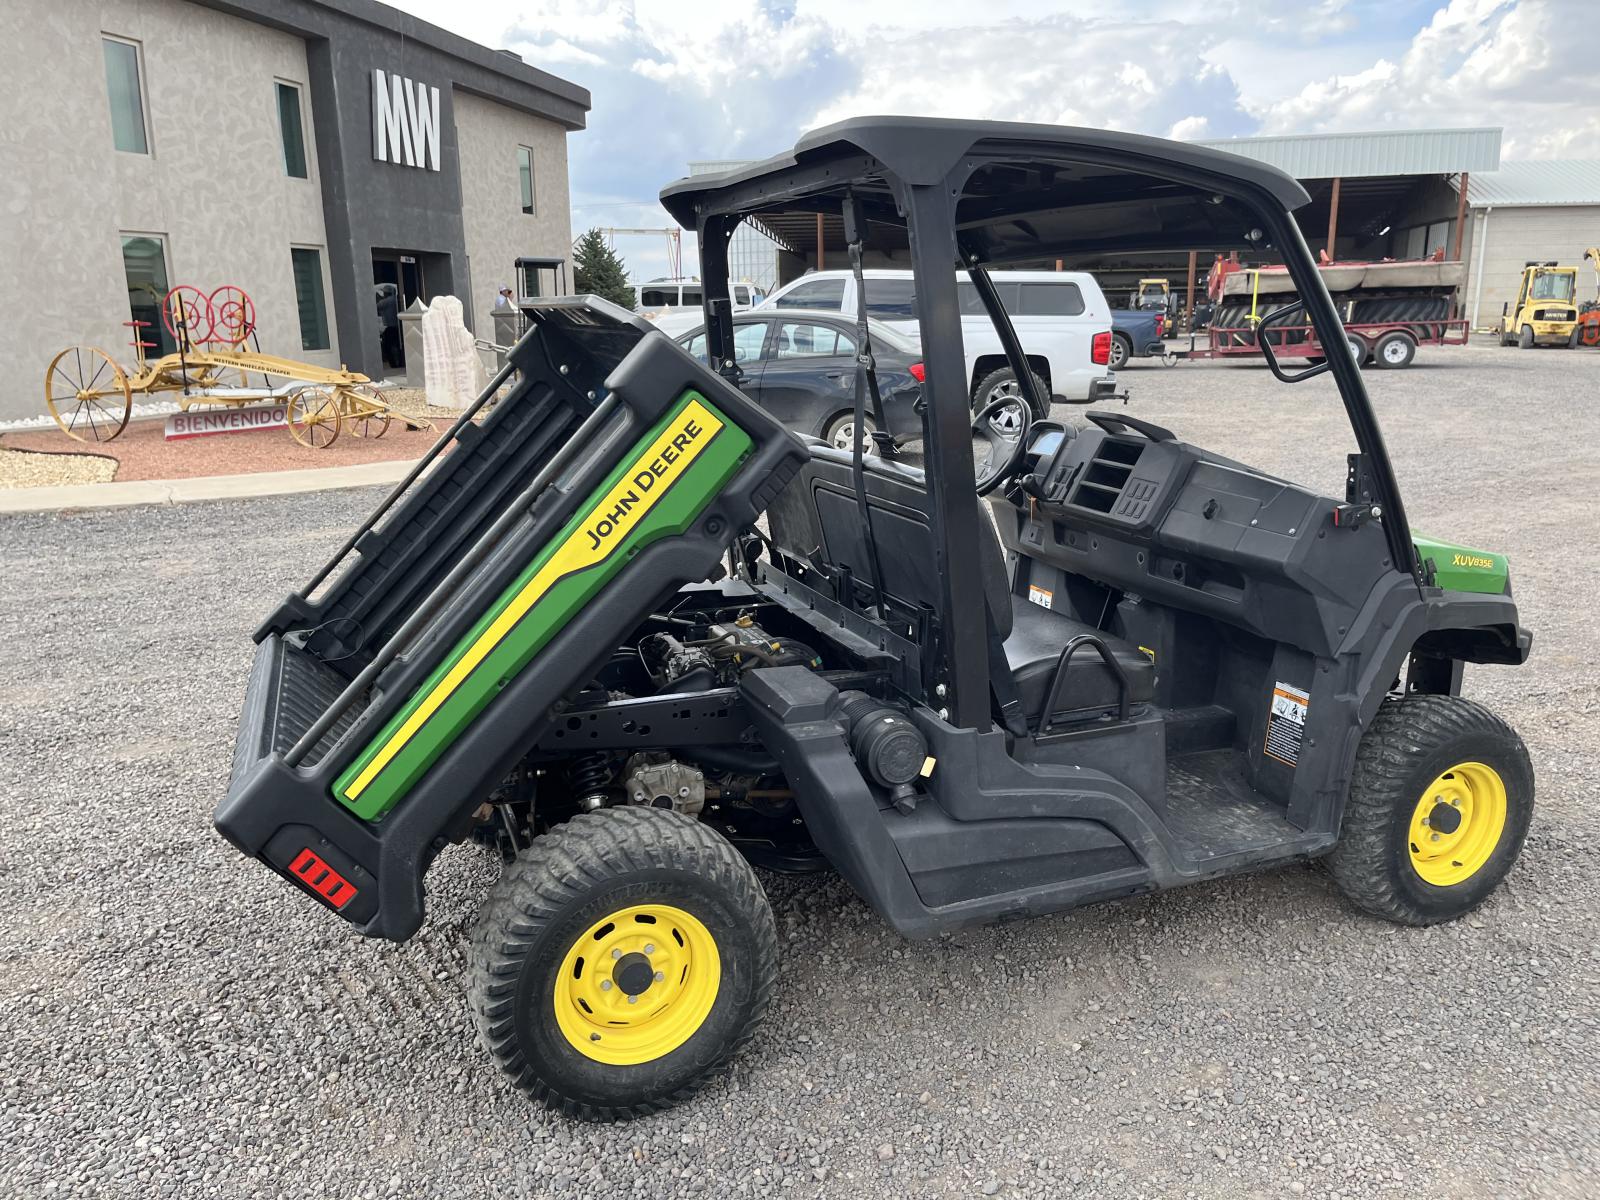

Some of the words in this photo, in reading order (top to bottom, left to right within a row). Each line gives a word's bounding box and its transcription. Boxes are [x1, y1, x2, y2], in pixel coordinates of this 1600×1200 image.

[372, 68, 441, 172] MW
[213, 357, 239, 367] WESTERN
[174, 409, 288, 433] BIENVENIDO
[586, 489, 641, 551] JOHN
[632, 419, 703, 493] DEERE
[1452, 553, 1493, 569] XUV835E
